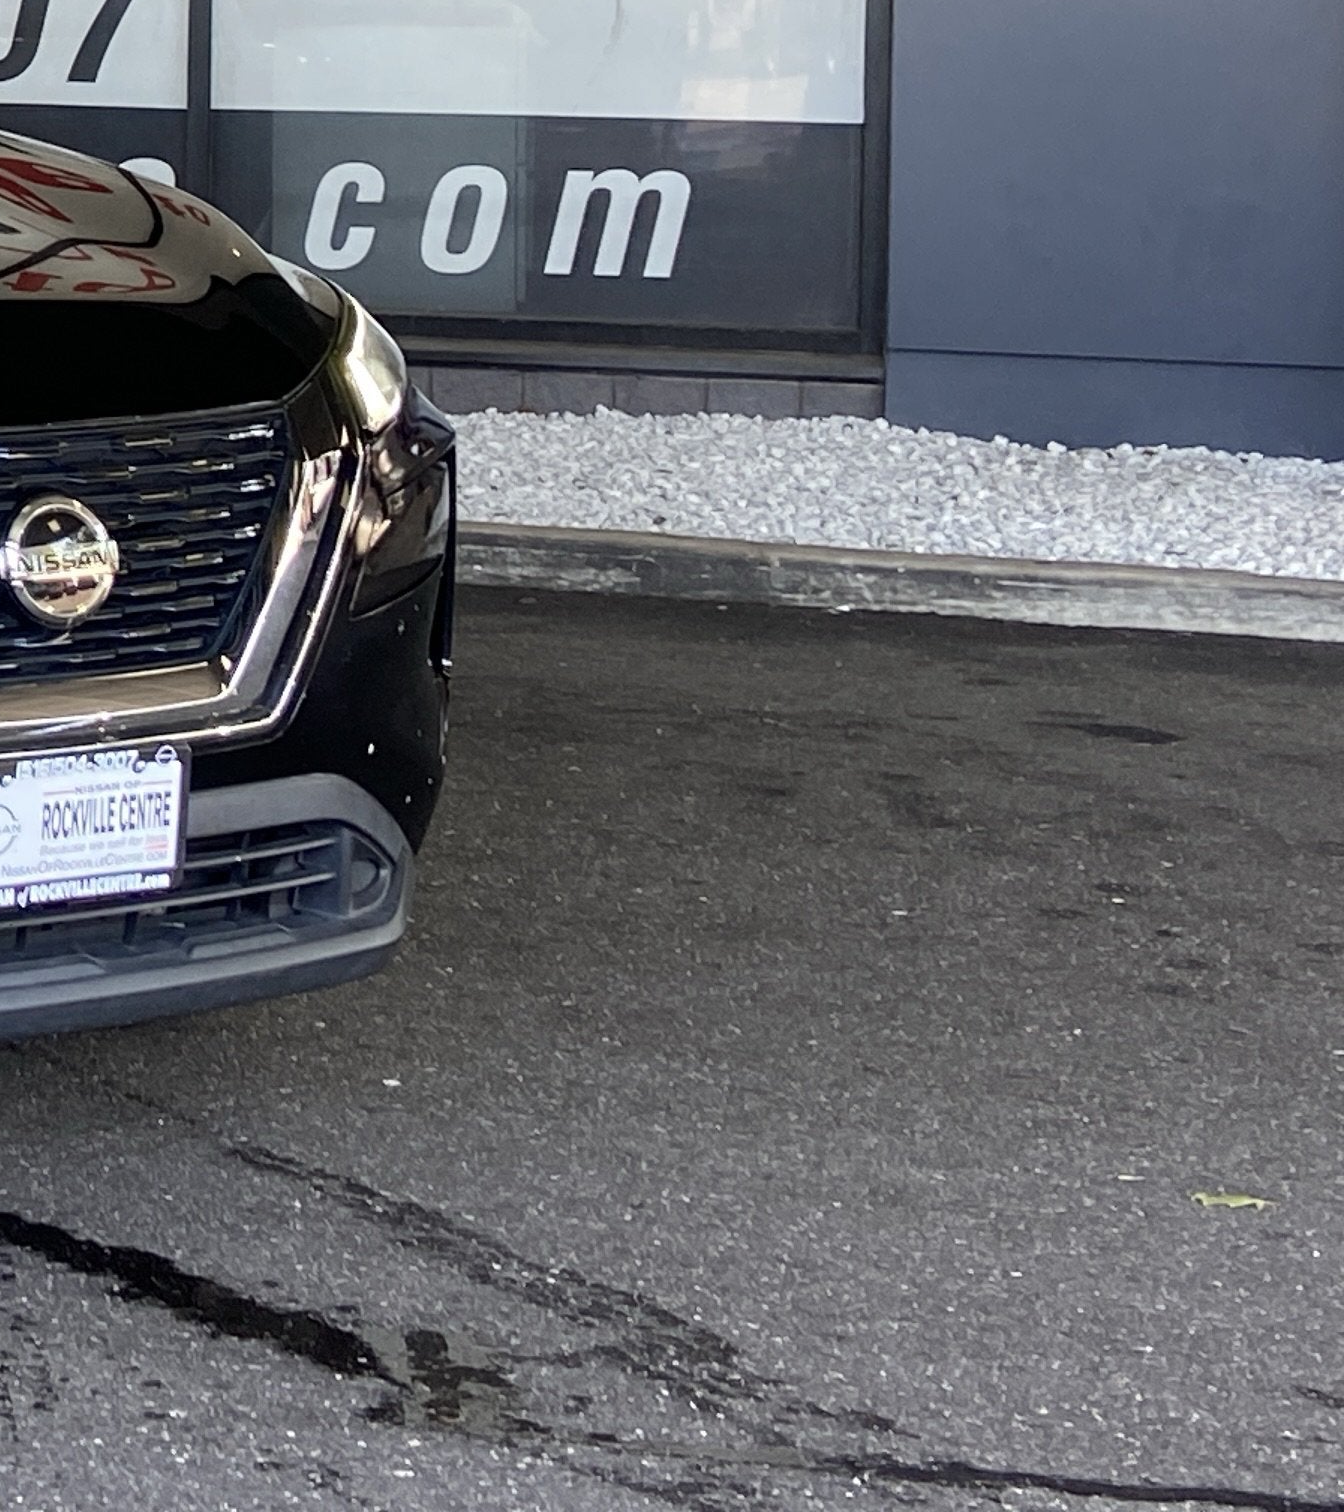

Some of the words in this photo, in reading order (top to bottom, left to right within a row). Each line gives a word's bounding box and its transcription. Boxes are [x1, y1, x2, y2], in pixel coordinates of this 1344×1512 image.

[17, 550, 108, 573] NISSAN
[74, 782, 121, 795] NISSAN
[41, 796, 116, 840] ROCKVILLE
[119, 791, 172, 830] CENTRE
